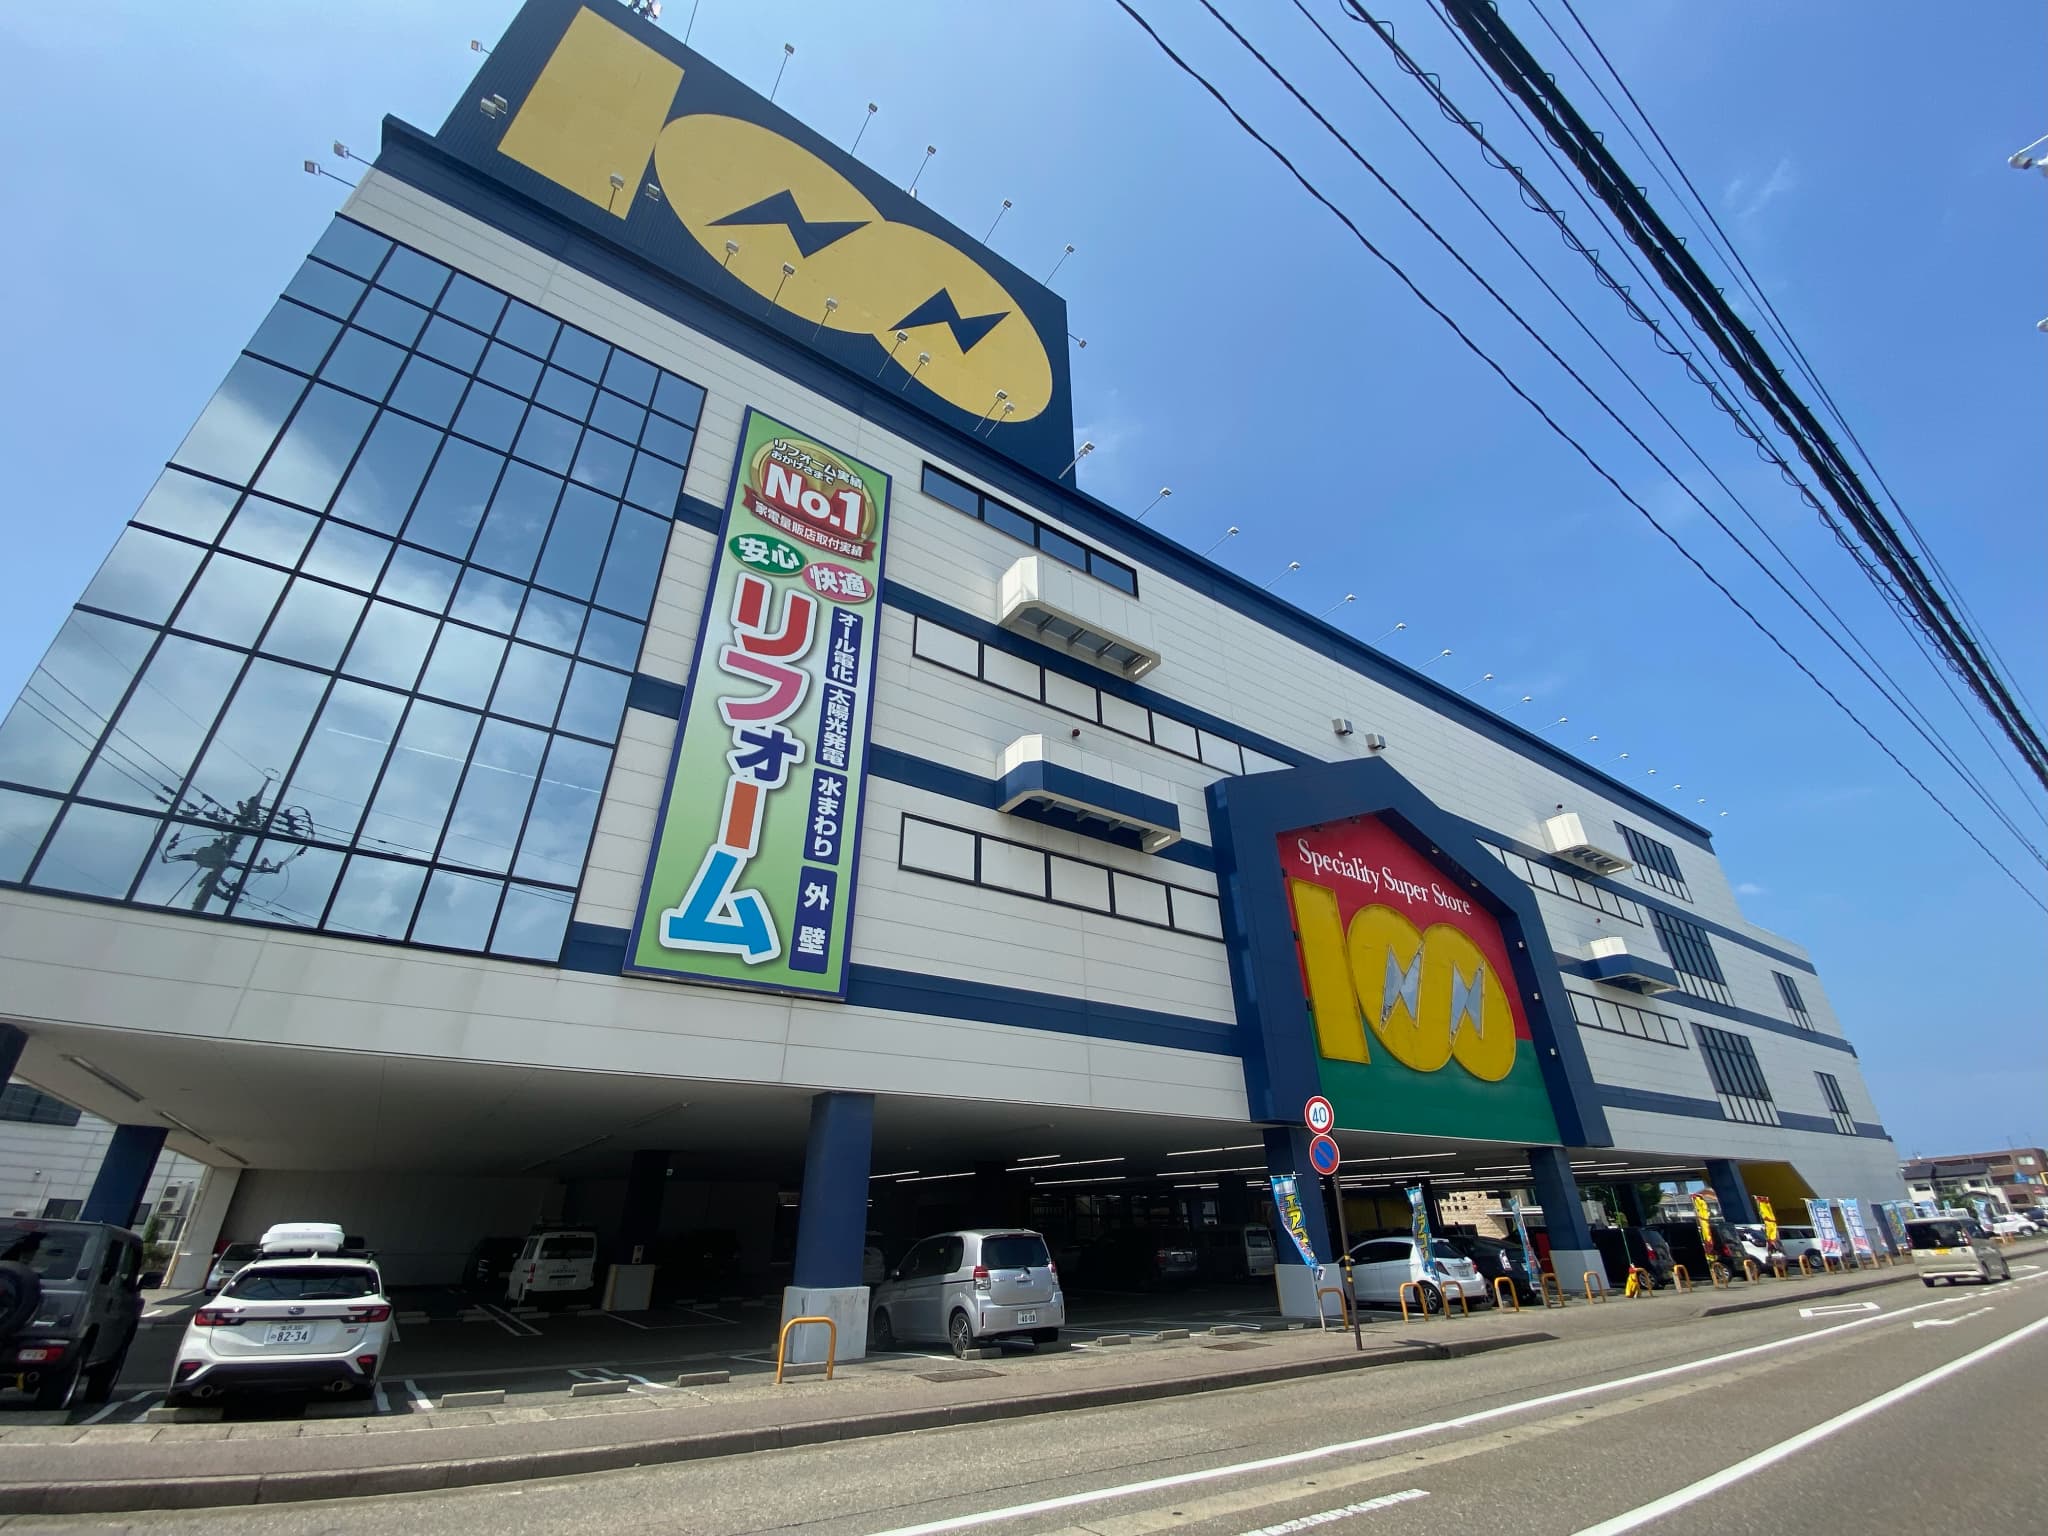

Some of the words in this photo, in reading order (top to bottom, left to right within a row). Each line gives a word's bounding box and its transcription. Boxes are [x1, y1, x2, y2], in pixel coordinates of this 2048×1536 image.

[765, 463, 861, 535] No.1
[771, 450, 834, 485] おかげさまで
[738, 537, 800, 570] 安心
[755, 500, 863, 557] 家電量販店取付実績
[809, 565, 867, 598] 快適
[831, 611, 857, 684] オール電化
[821, 688, 851, 767] 太陽光発電
[665, 573, 814, 959] リフォーム
[813, 776, 842, 857] 水まわり
[1298, 838, 1380, 894] Speciality
[1382, 866, 1429, 904] Super
[1431, 883, 1472, 916] Store
[797, 882, 830, 956] 外壁
[1312, 1106, 1327, 1124] 40
